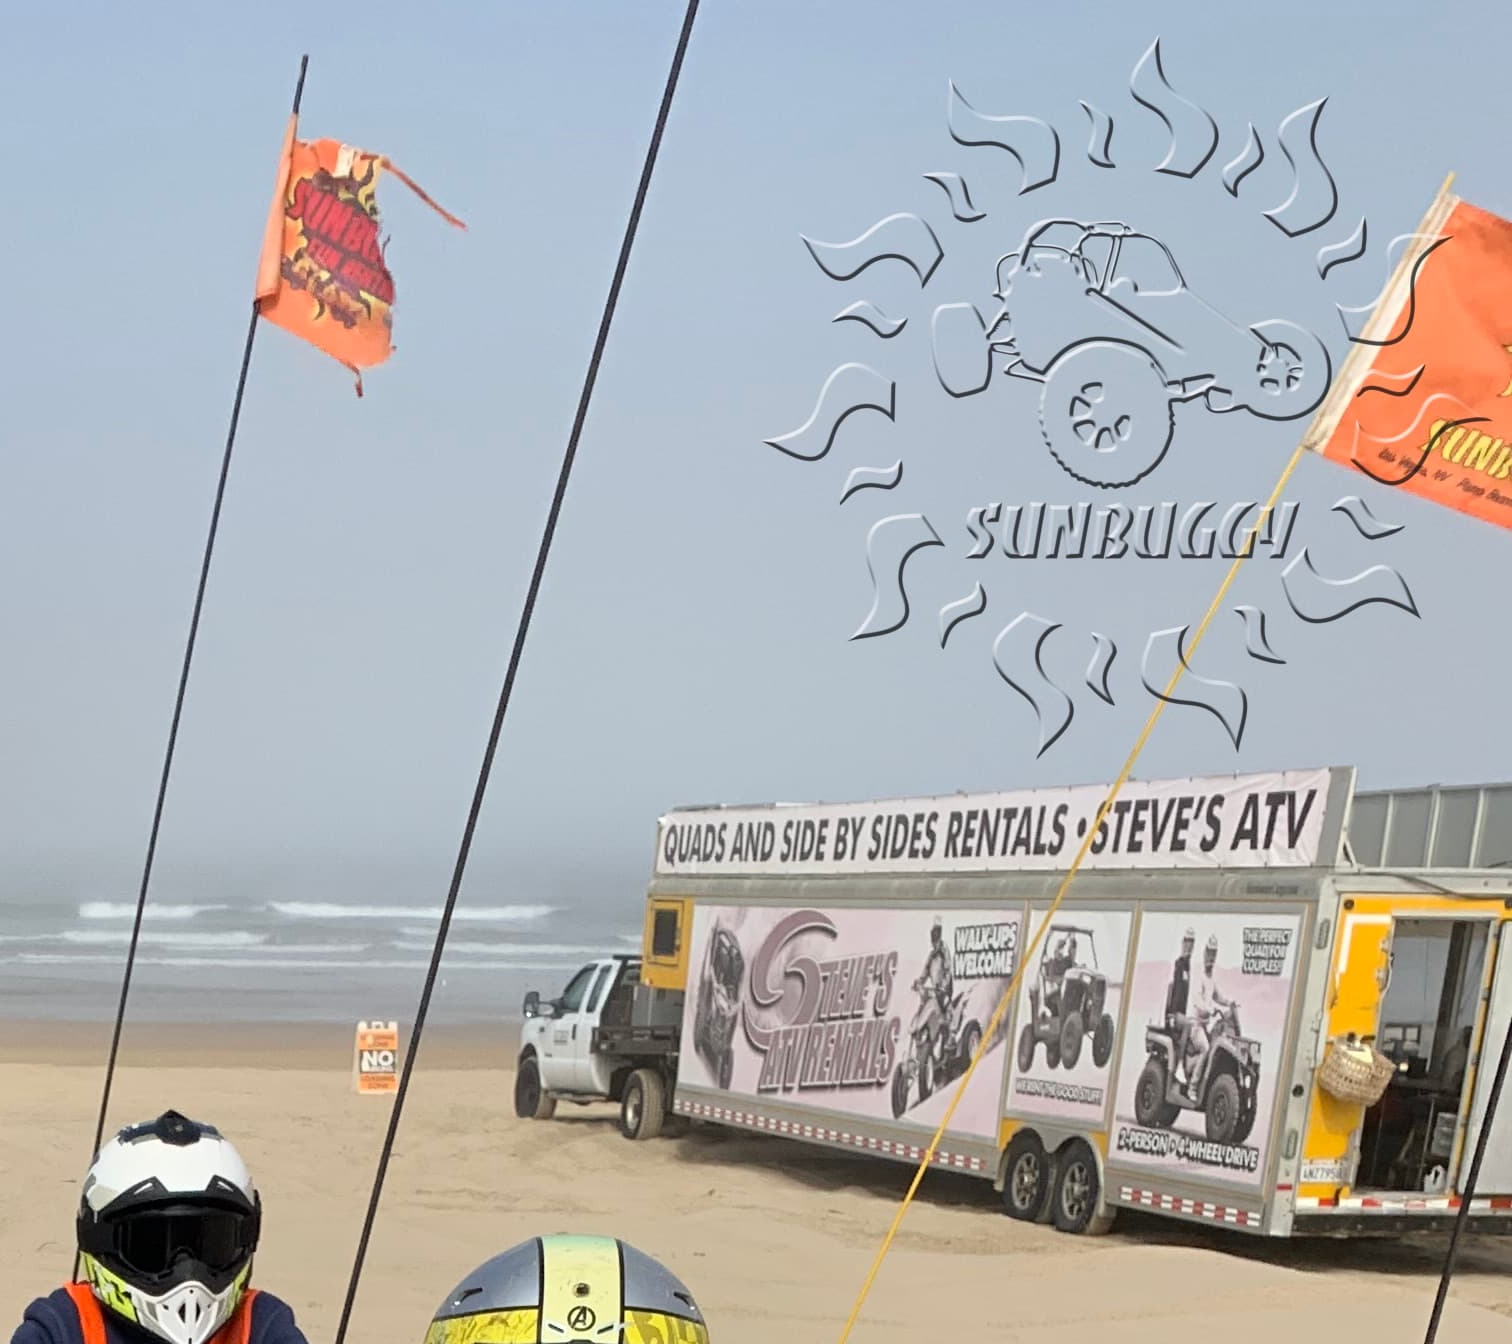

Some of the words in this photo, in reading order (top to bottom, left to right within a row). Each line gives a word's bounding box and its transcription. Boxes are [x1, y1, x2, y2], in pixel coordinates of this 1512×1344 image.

[664, 822, 727, 866] QUADS
[730, 821, 775, 862] AND
[780, 818, 829, 862] SIDE
[833, 815, 867, 861] BY
[868, 811, 939, 861] SIDES
[944, 803, 1069, 859] RENTALS
[1090, 794, 1225, 854] STEVE'S
[1230, 788, 1317, 850] ATV
[955, 922, 1018, 951] WALK-UPS
[954, 950, 1014, 978] WELCOME
[361, 1050, 394, 1067] NO
[800, 1015, 900, 1090] RENTALS
[1118, 1128, 1169, 1157] 2-PERSON
[1224, 1145, 1259, 1173] DRIVE
